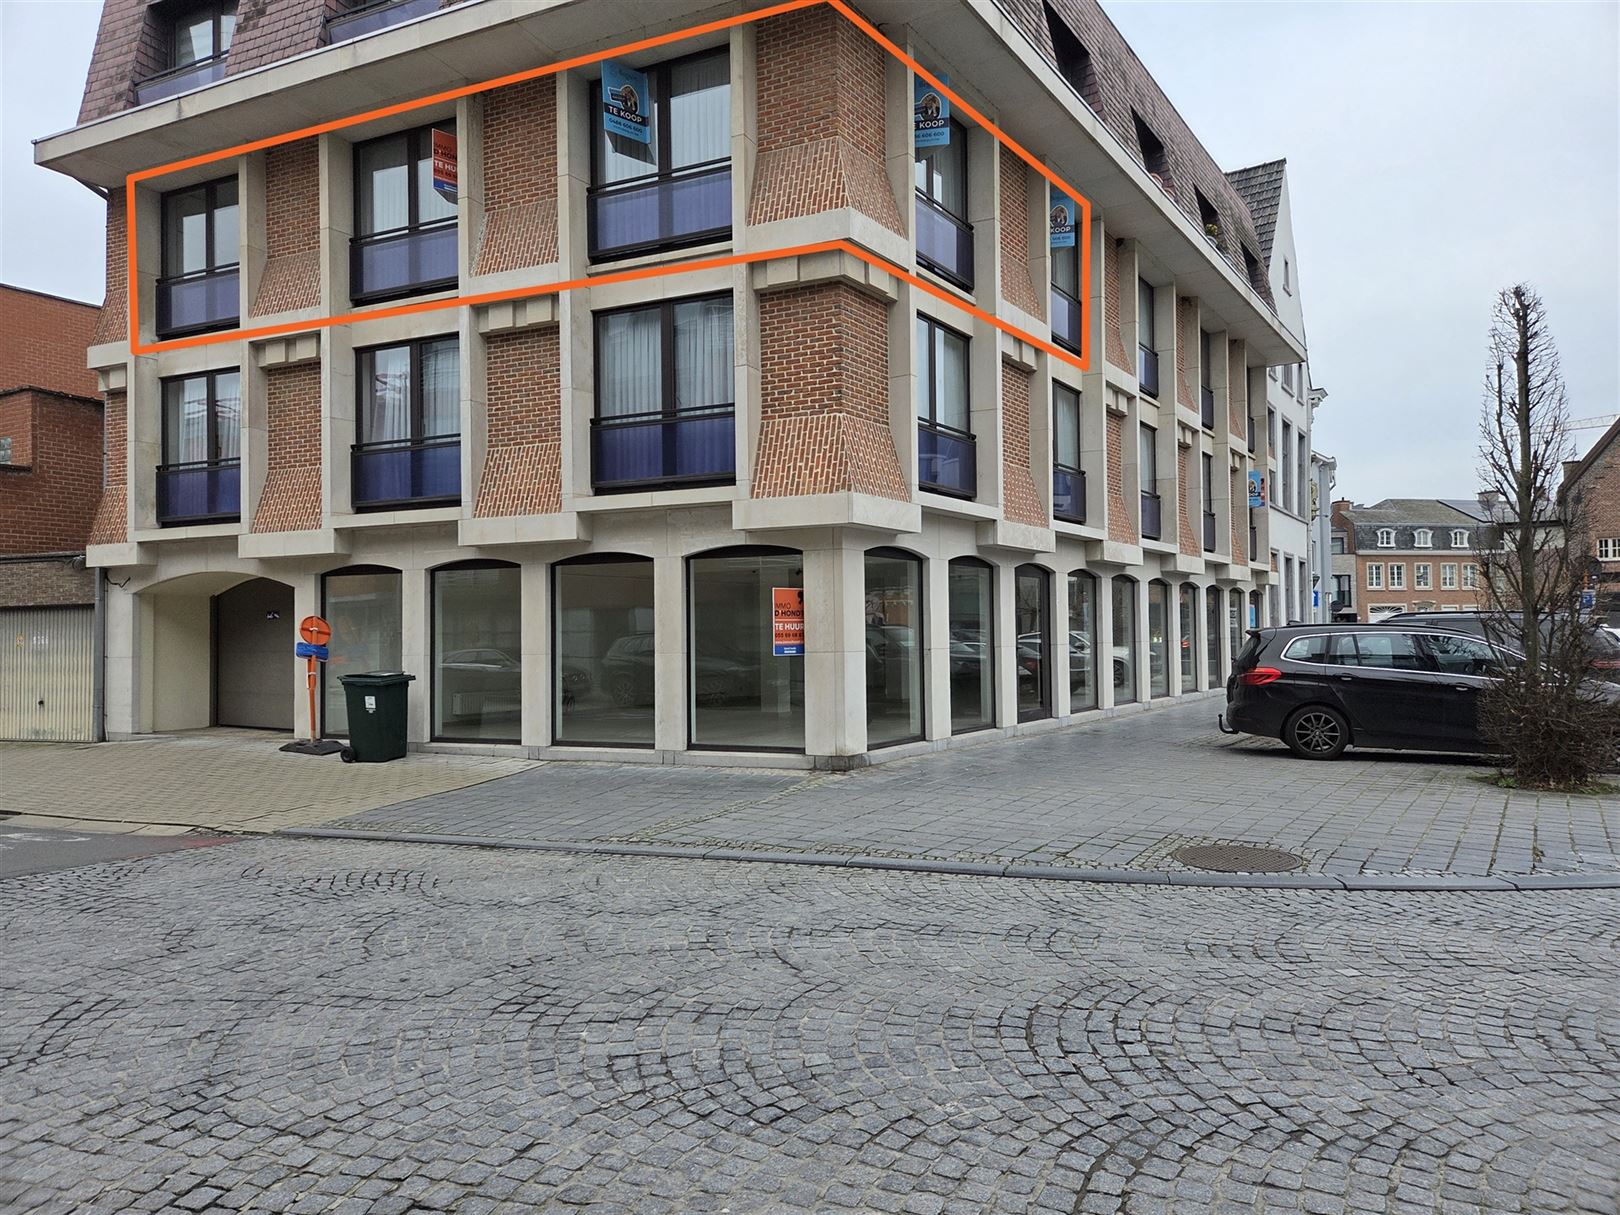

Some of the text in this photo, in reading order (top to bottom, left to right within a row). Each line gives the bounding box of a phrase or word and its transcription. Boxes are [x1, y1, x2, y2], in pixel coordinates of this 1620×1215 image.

[608, 105, 642, 122] TE KOOP
[919, 120, 944, 129] KOOP
[434, 160, 444, 169] TE
